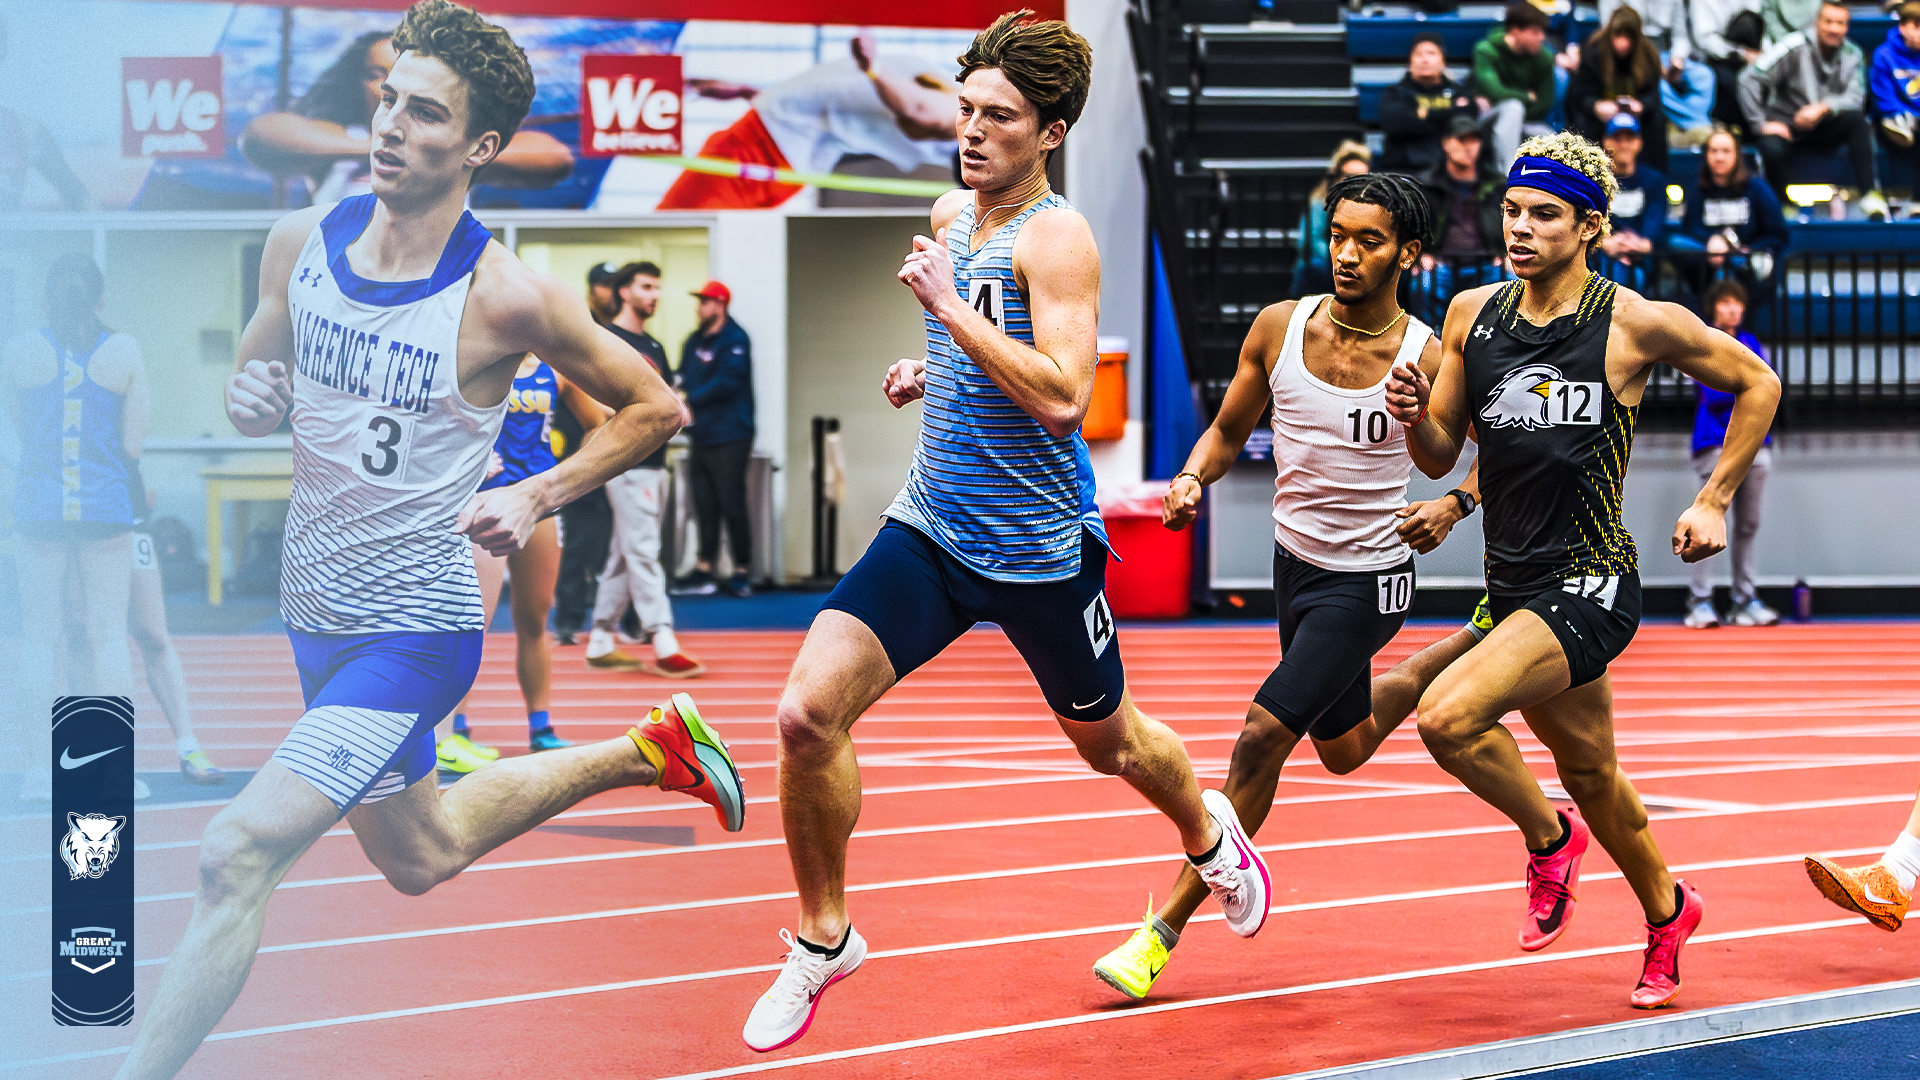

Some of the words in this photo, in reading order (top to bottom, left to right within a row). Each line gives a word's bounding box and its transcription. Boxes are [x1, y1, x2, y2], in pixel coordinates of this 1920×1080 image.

[126, 79, 220, 132] We
[587, 74, 680, 131] We
[973, 284, 998, 327] 4
[381, 340, 440, 414] TECH
[1348, 408, 1388, 444] 10
[1557, 384, 1592, 422] 12
[361, 416, 402, 477] 3
[137, 538, 152, 566] 9
[1381, 575, 1409, 612] 10
[1093, 595, 1110, 644] 4
